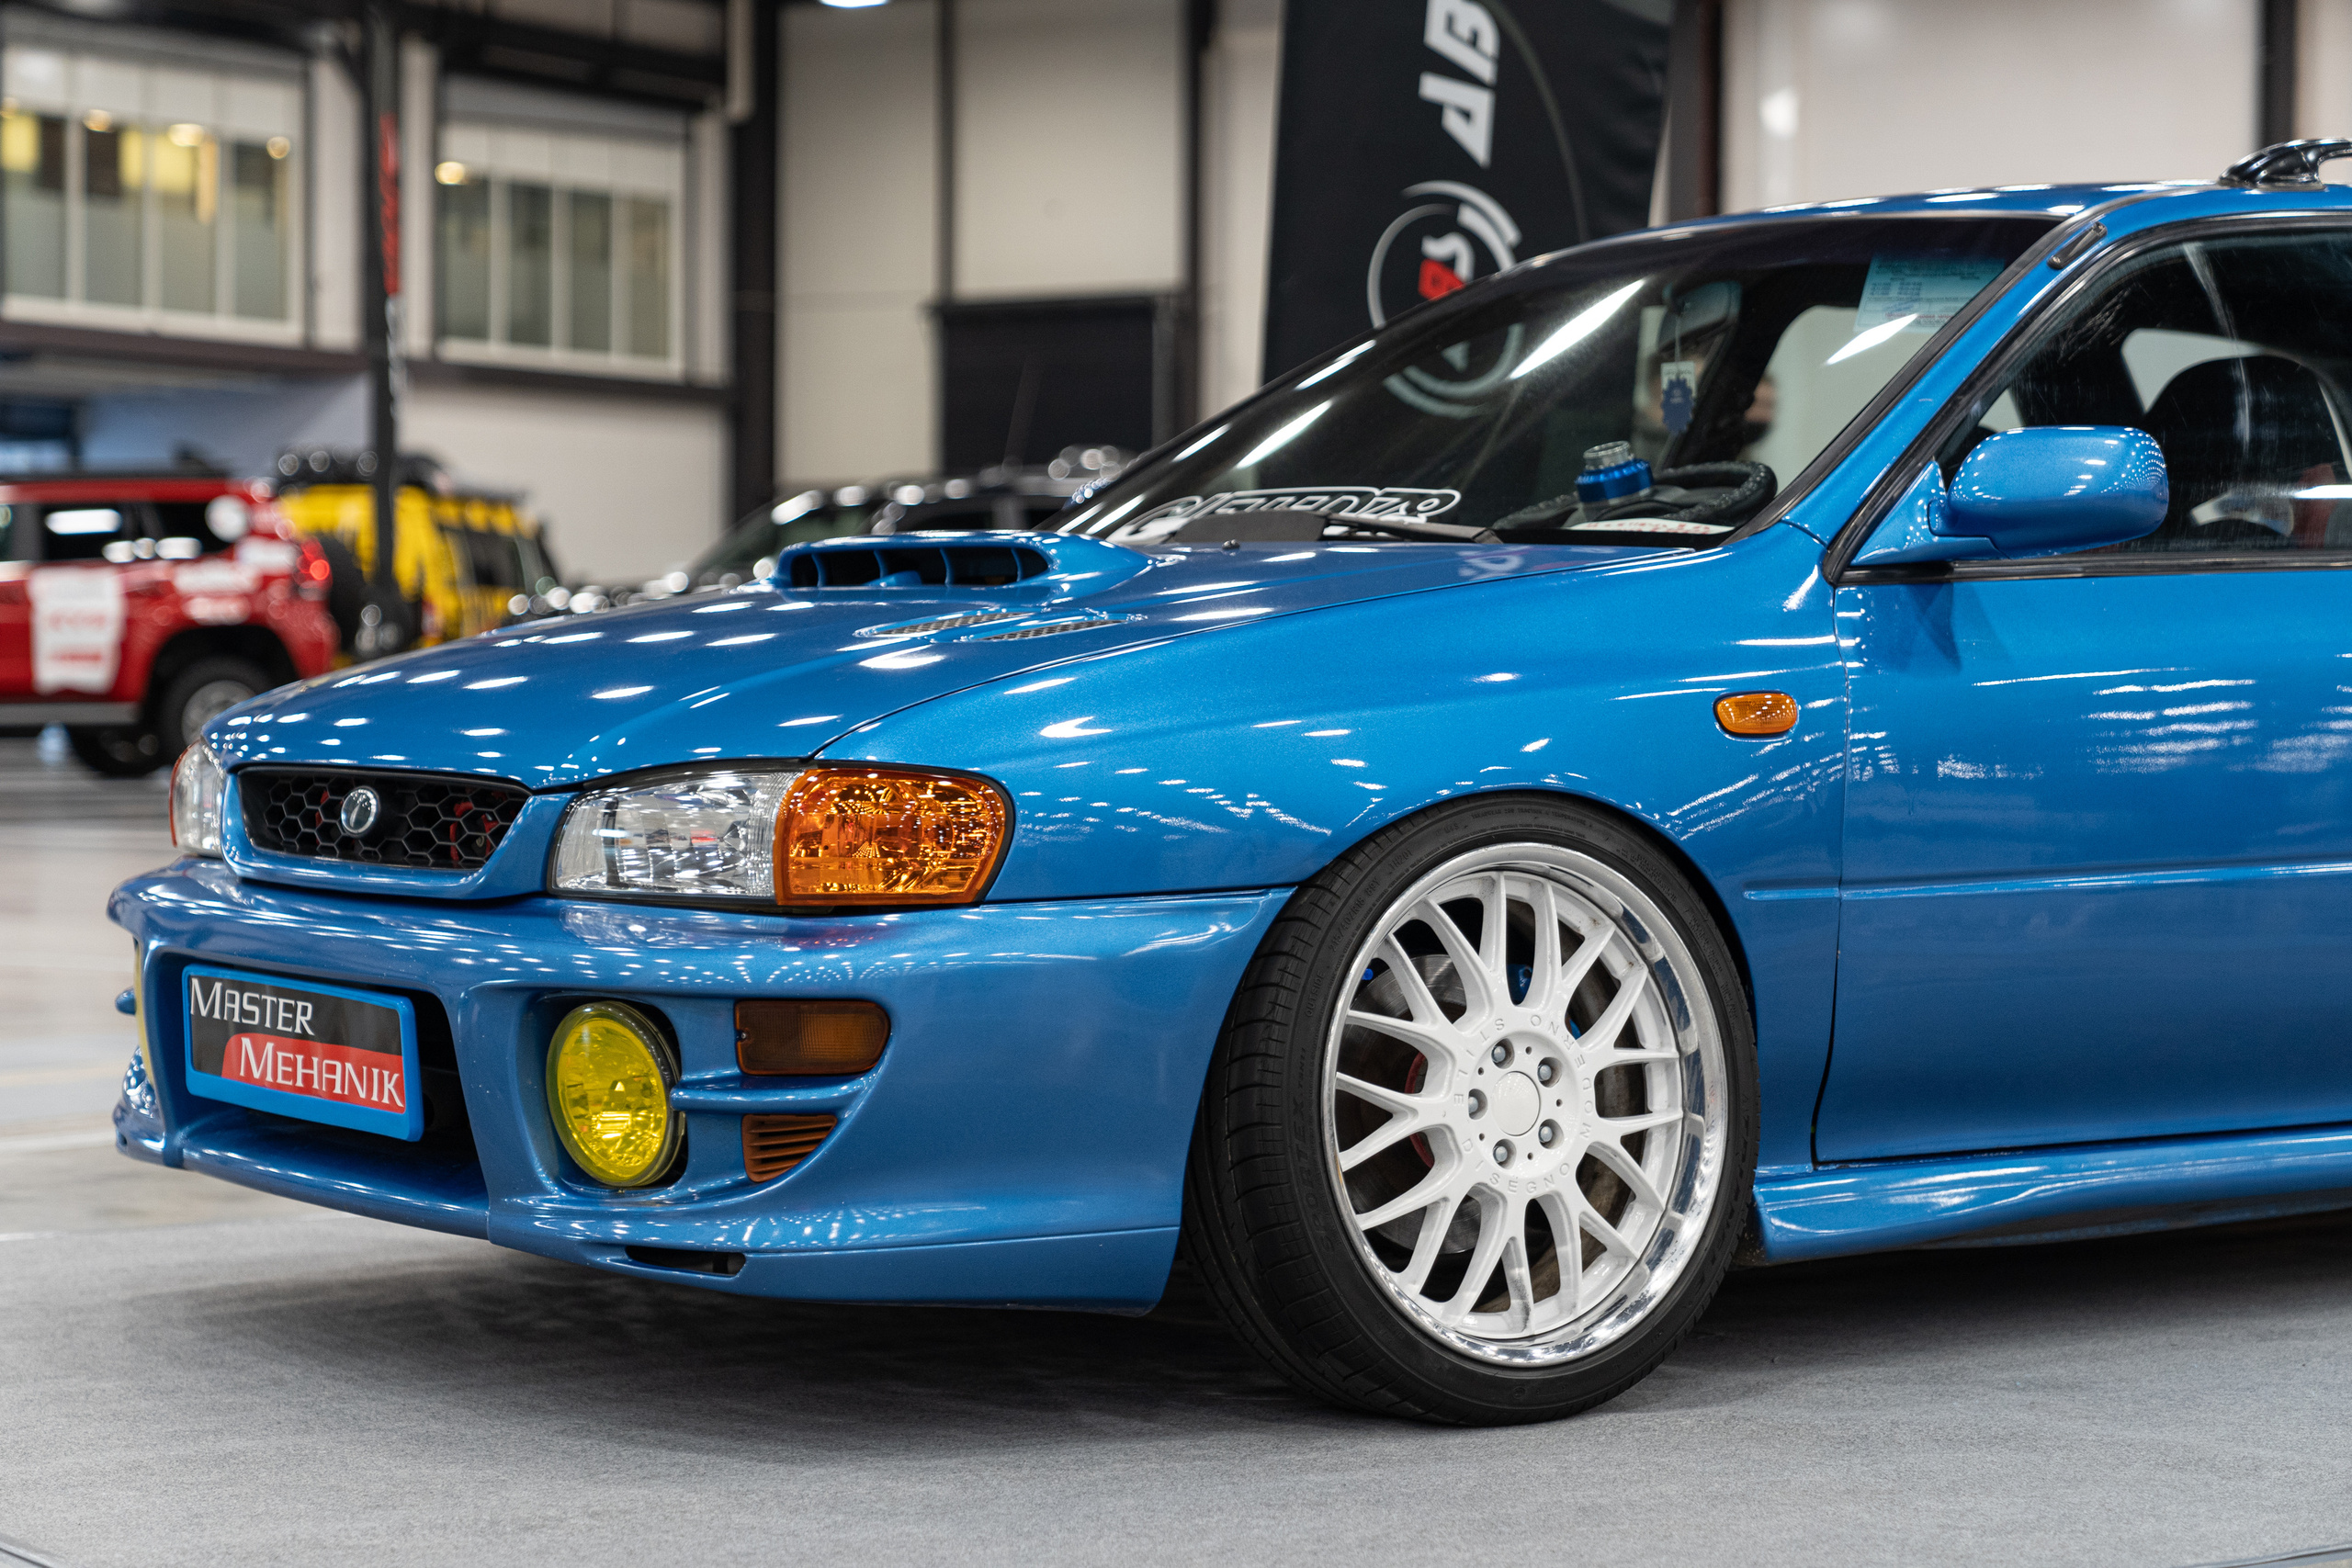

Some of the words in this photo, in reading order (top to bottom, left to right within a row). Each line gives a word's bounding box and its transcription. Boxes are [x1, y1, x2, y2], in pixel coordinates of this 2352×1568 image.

[190, 977, 315, 1035] MASTER
[1304, 968, 1325, 1018] OUTSIDE
[239, 1037, 404, 1108] MEHANIK
[1453, 1018, 1506, 1106] STILE
[1530, 1014, 1592, 1139] MODERNO
[1292, 1096, 1335, 1254] SPORTEX
[1461, 1138, 1571, 1194] DISEGNO
